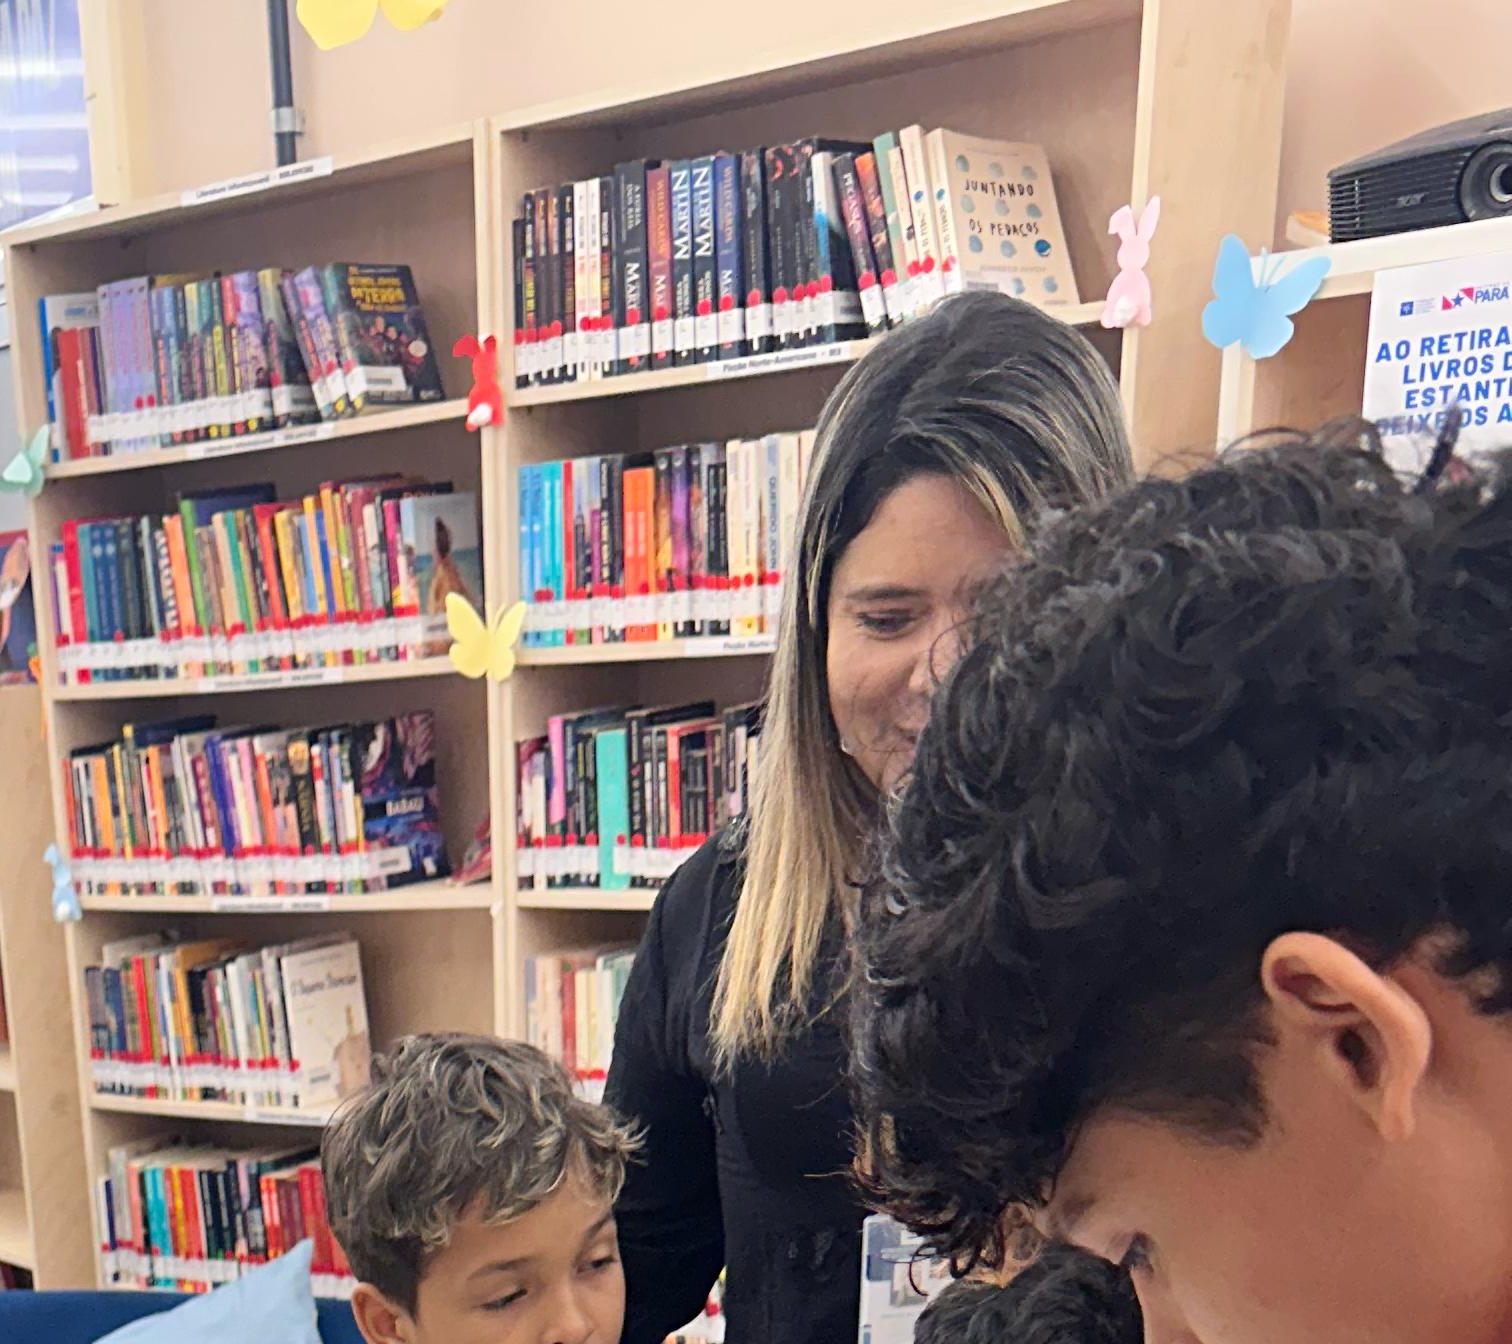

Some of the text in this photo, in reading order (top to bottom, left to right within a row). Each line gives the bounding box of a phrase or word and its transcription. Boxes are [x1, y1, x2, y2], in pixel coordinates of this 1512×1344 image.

[964, 179, 1035, 198] JUNTANDO
[672, 169, 690, 260] MARTIN
[693, 166, 712, 257] MARTIN
[968, 217, 1039, 238] OS PEDAÇOS
[1376, 340, 1411, 363] AO
[1403, 354, 1494, 384] LIVROS
[1405, 377, 1512, 409] ESTANT
[769, 476, 778, 569] QUERIDO JOHN
